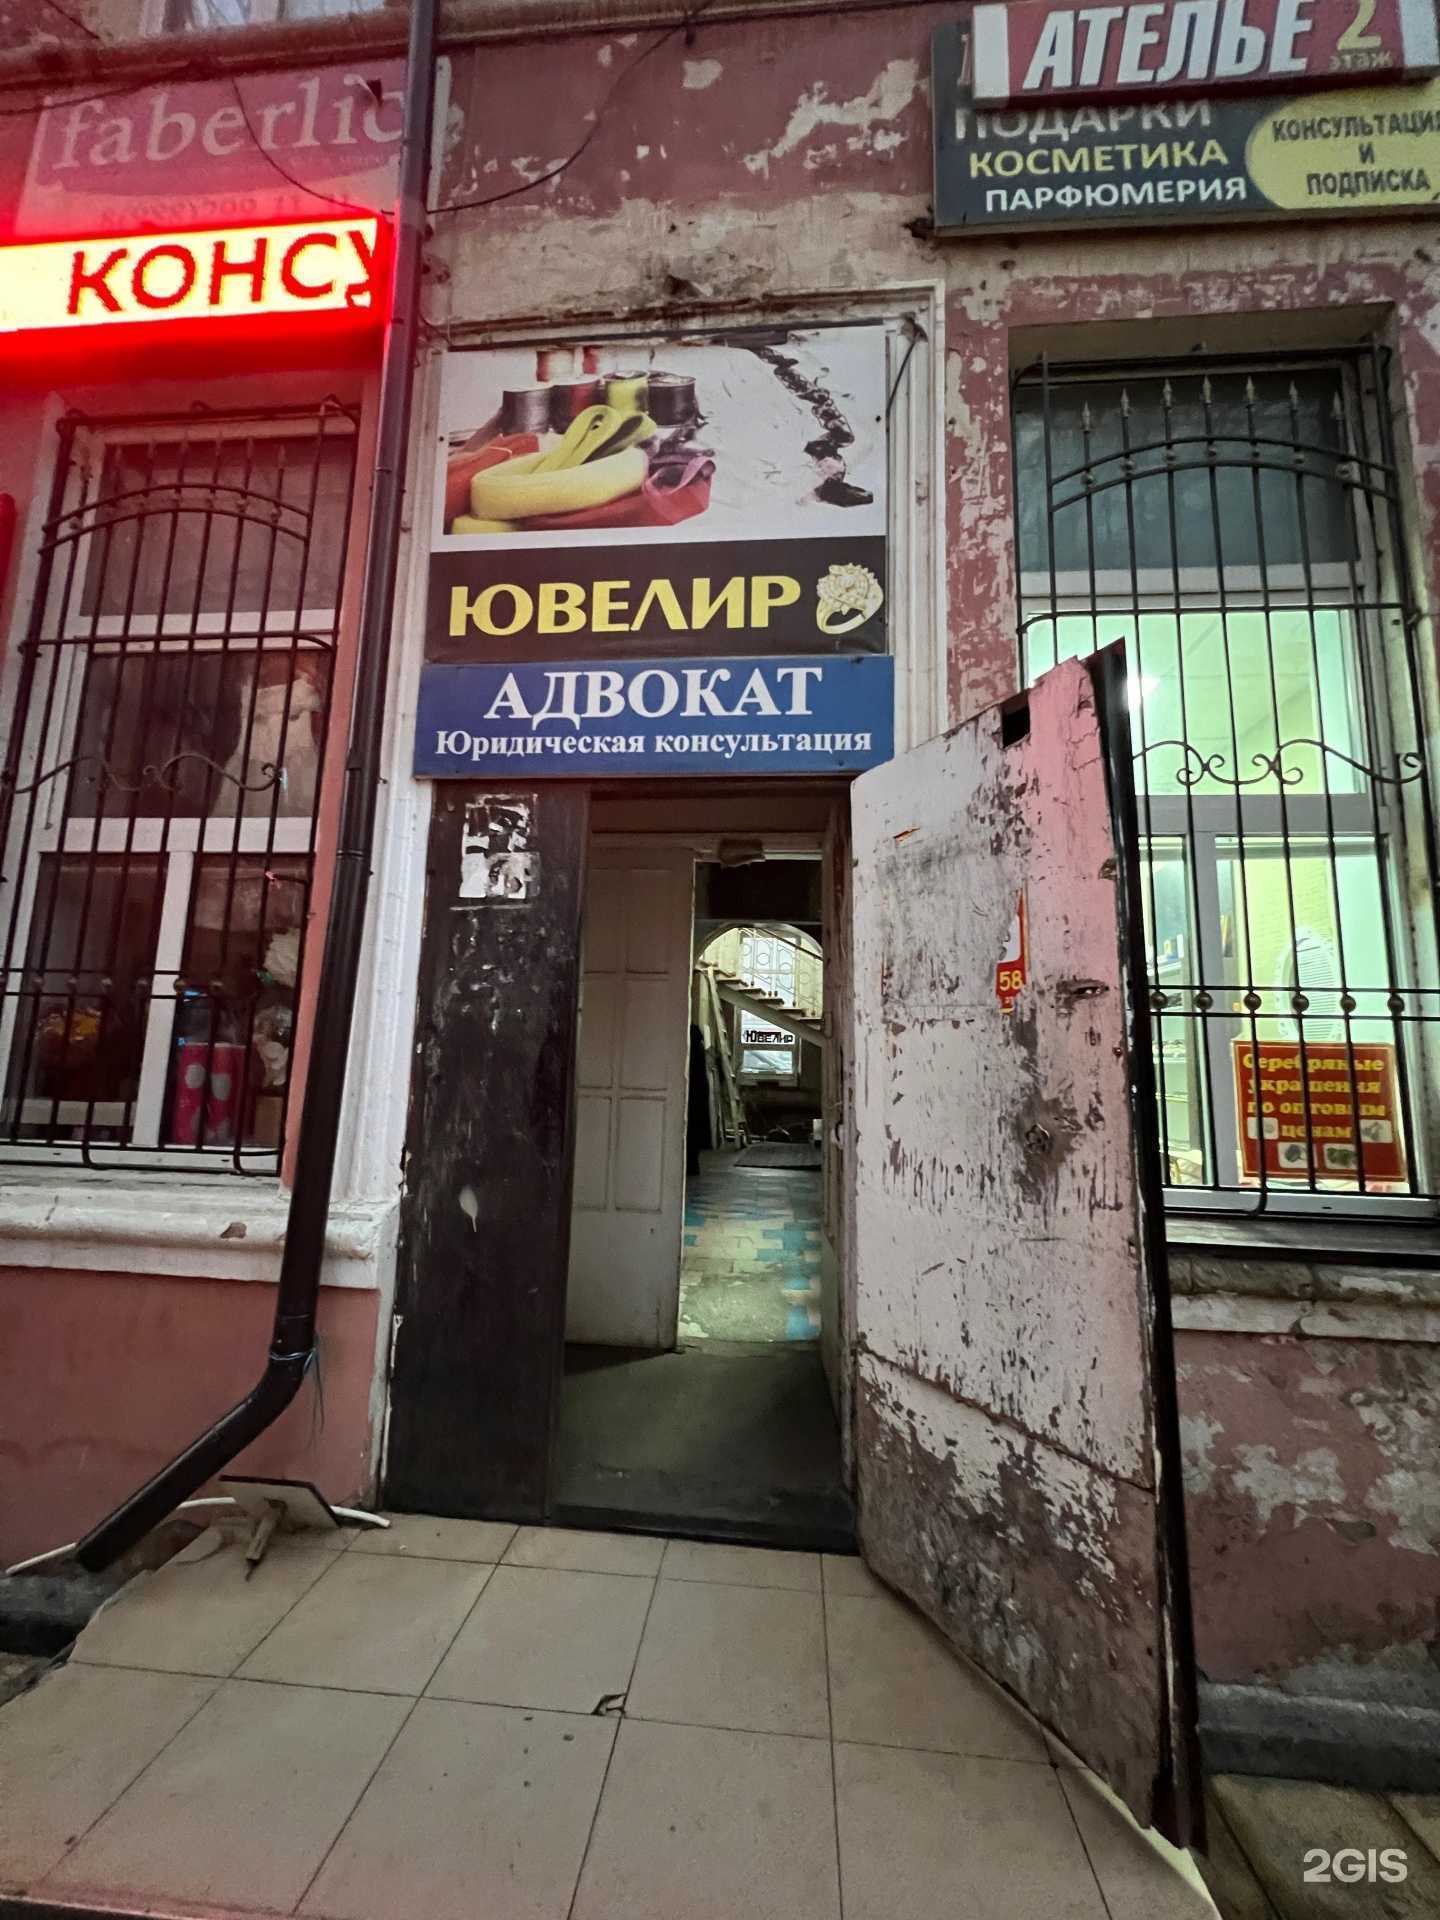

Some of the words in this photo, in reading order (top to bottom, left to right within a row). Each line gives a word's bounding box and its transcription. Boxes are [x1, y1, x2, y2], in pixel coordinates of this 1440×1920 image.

[1022, 0, 1313, 88] АТЕЛЬЕ
[1336, 0, 1382, 50] 2
[969, 139, 1229, 178] КОСМЕТИКА
[1358, 142, 1375, 164] И
[985, 176, 1247, 213] ПАРФЮМЕРИЯ
[1306, 168, 1431, 198] ПОДПИСКА
[448, 575, 801, 637] ЮВЕЛИР
[483, 667, 823, 730] АДВОКАТ
[436, 730, 645, 760] Юридическая
[653, 732, 872, 760] консультация
